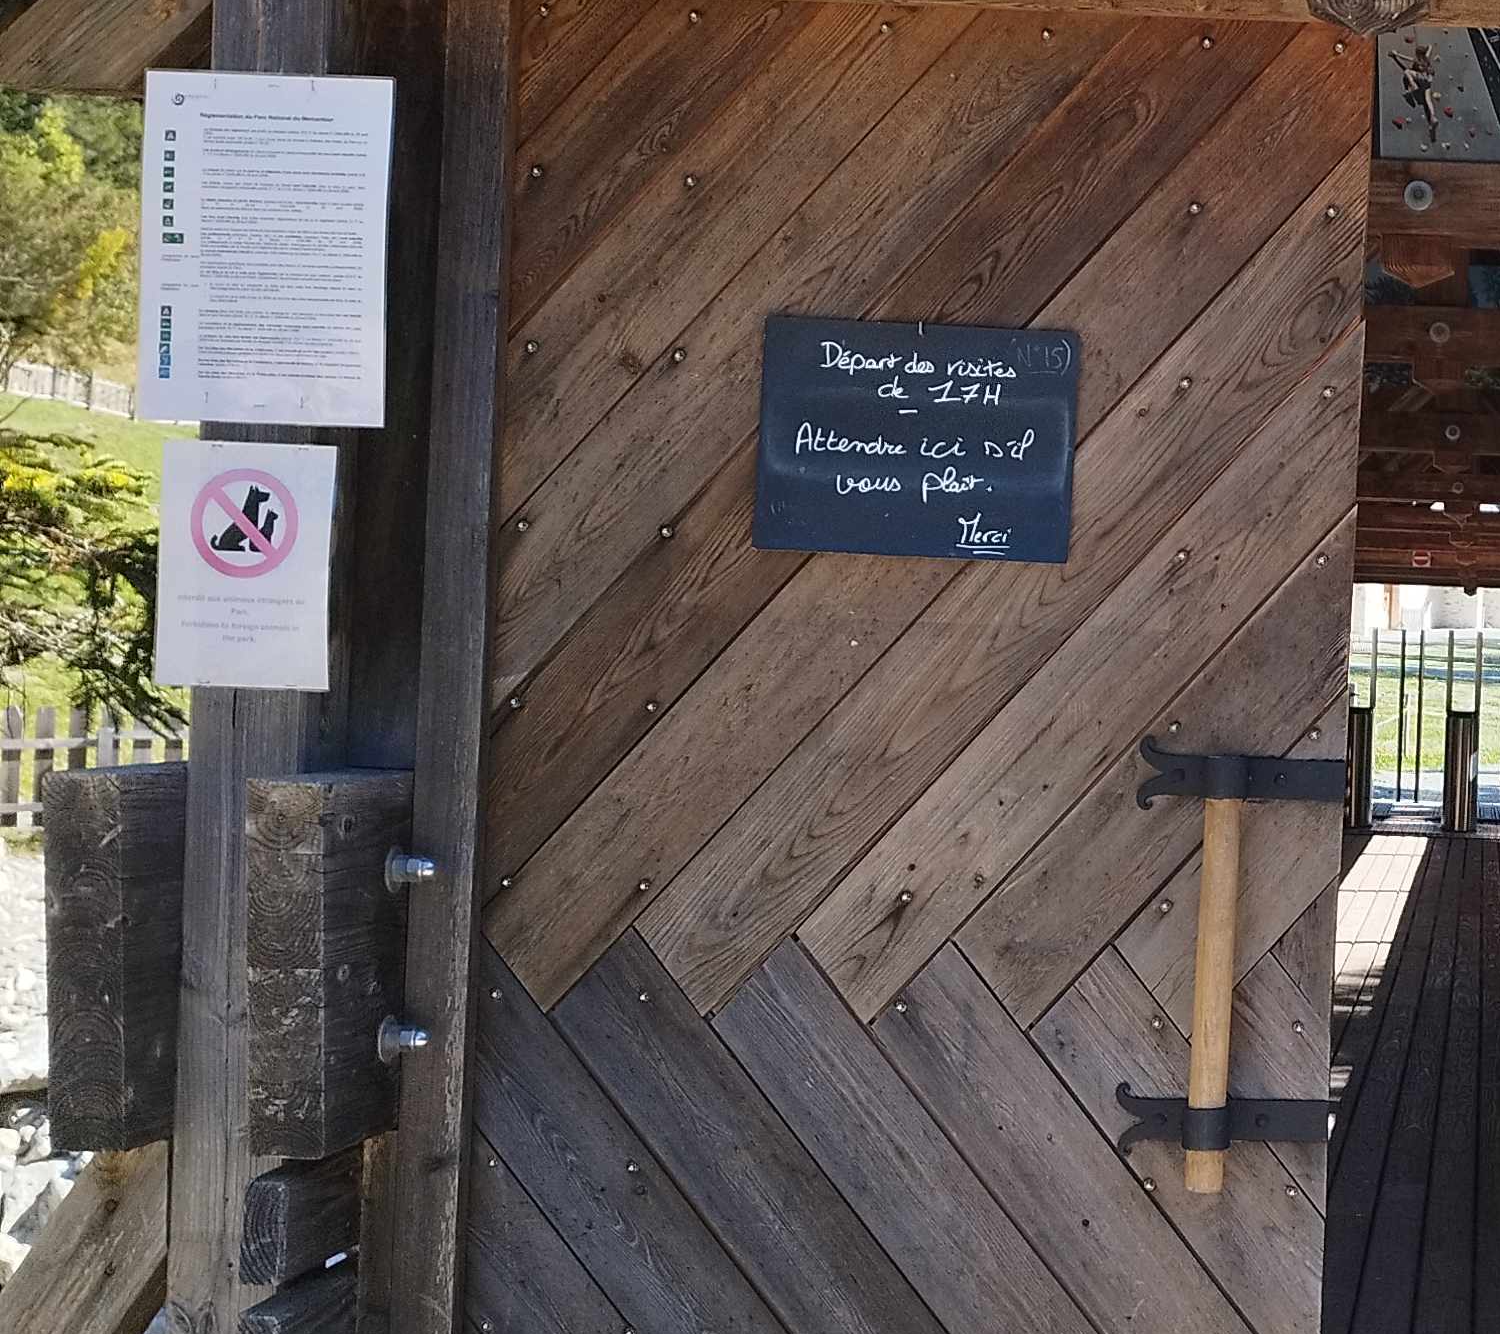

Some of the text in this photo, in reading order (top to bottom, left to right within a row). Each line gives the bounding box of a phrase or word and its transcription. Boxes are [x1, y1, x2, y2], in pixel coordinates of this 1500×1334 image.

[820, 339, 1017, 378] Départ des visites
[877, 375, 1002, 406] de 17H
[795, 421, 907, 457] Attendre
[919, 436, 967, 459] ici
[835, 472, 902, 495] vous
[956, 512, 1012, 545] Merci
